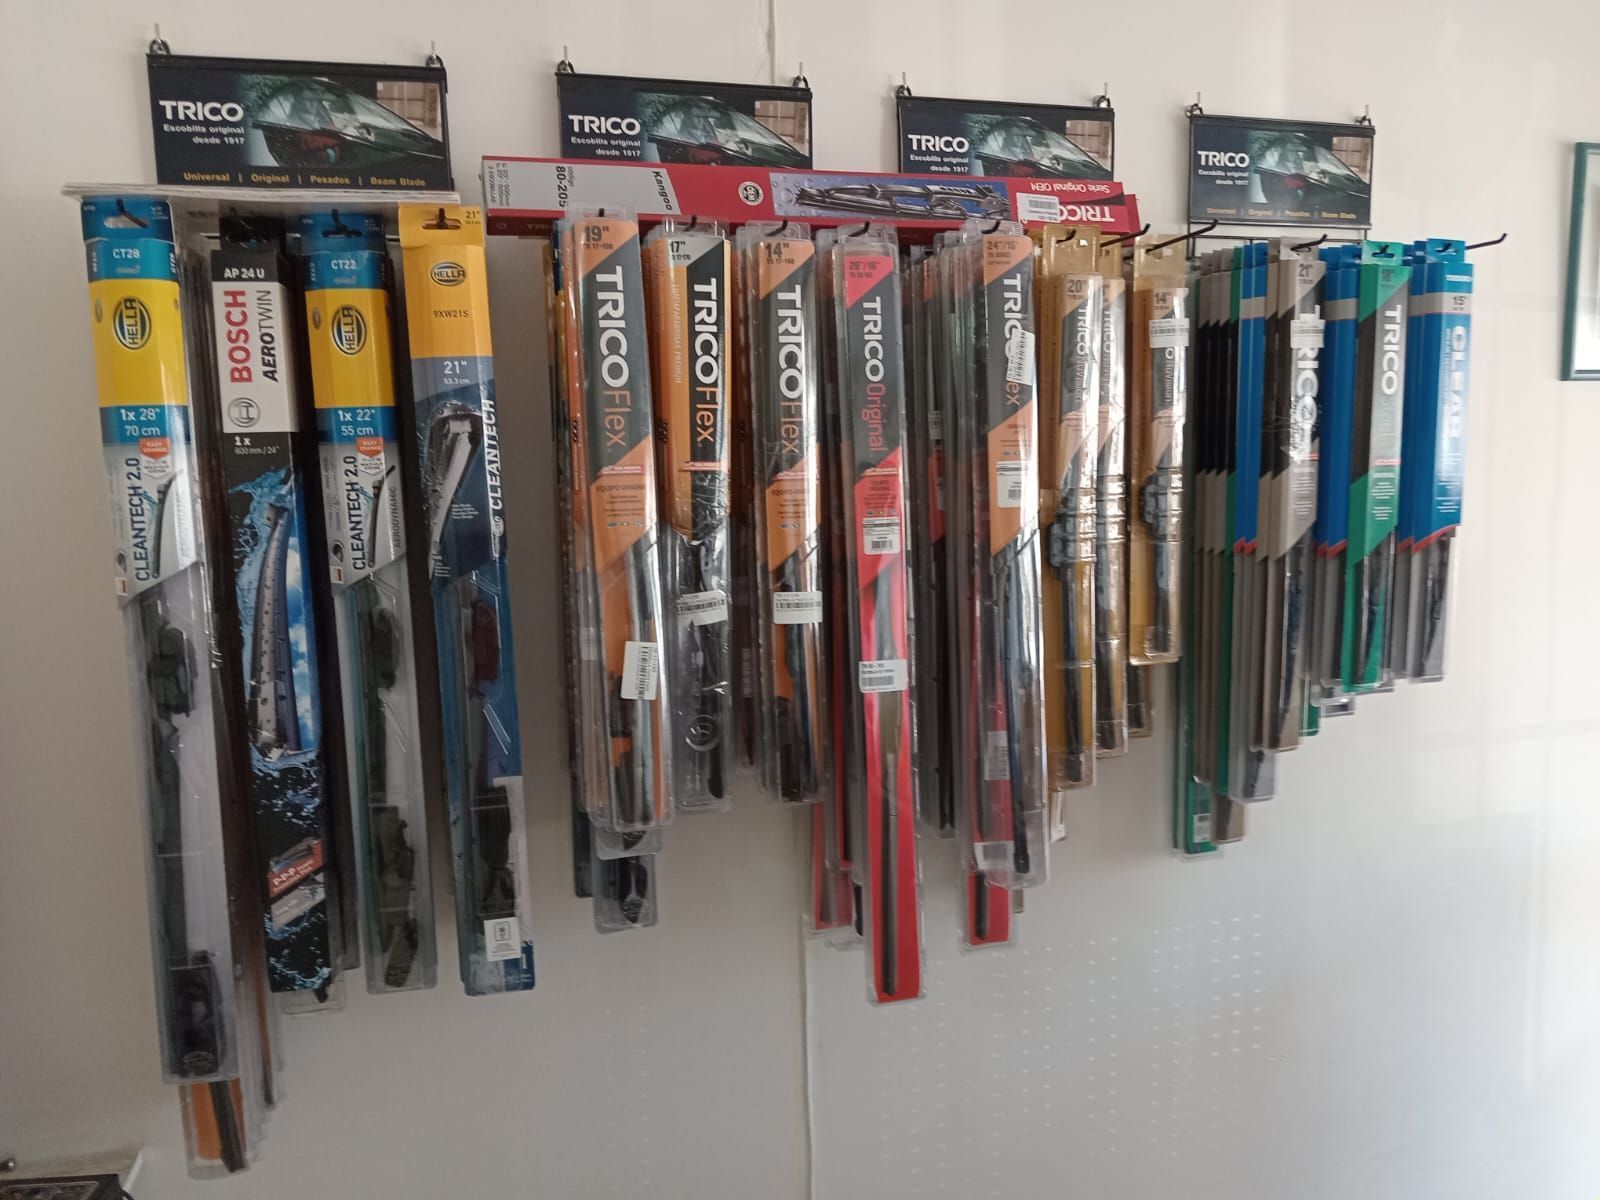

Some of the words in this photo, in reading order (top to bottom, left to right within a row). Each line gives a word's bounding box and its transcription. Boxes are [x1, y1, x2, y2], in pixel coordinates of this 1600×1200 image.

[159, 100, 244, 122] TRICO
[163, 124, 206, 134] Escobilla
[209, 125, 244, 135] original
[568, 115, 641, 136] TRICO
[192, 136, 221, 145] desde
[223, 137, 244, 145] 1917
[571, 137, 608, 146] Escobilla
[610, 138, 641, 148] original
[908, 135, 969, 152] TRICO
[910, 154, 941, 163] Escobilla
[943, 156, 968, 164] original
[1198, 151, 1249, 167] TRICO
[183, 172, 229, 182] Universal
[251, 173, 290, 184] Original
[310, 175, 349, 184] Pesados
[370, 177, 396, 186] Beam
[400, 178, 425, 187] Blade
[556, 166, 568, 208] 80-205
[1030, 182, 1051, 191] OEM
[1053, 182, 1086, 192] Original
[652, 170, 673, 211] Kangoo
[1087, 184, 1110, 193] Serie
[1058, 205, 1115, 222] TRICO
[584, 225, 610, 243] 19"
[112, 248, 140, 259] CT28
[765, 242, 789, 258] 14"
[331, 260, 357, 270] CT22
[224, 268, 239, 278] AP
[242, 268, 255, 278] 24
[257, 268, 265, 279] U
[433, 268, 466, 279] HELLA
[123, 298, 139, 345] HELLA
[433, 310, 469, 318] 9XW21S
[341, 306, 355, 351] HELLA
[224, 290, 252, 383] BOSCH
[256, 290, 279, 383] AEROTWIN
[443, 361, 467, 374] 21"
[120, 409, 135, 421] 1x
[140, 408, 161, 421] 28"
[338, 410, 352, 422] 1x
[356, 409, 375, 421] 22"
[125, 425, 139, 436] 70
[142, 427, 160, 436] cm
[341, 426, 354, 436] 55
[357, 427, 373, 436] cm
[485, 399, 503, 510] CLEANTECH
[125, 457, 142, 481] 2.0
[343, 455, 358, 477] 2.0
[128, 484, 150, 581] CLEANTECH
[345, 480, 366, 570] CLEANTECH
